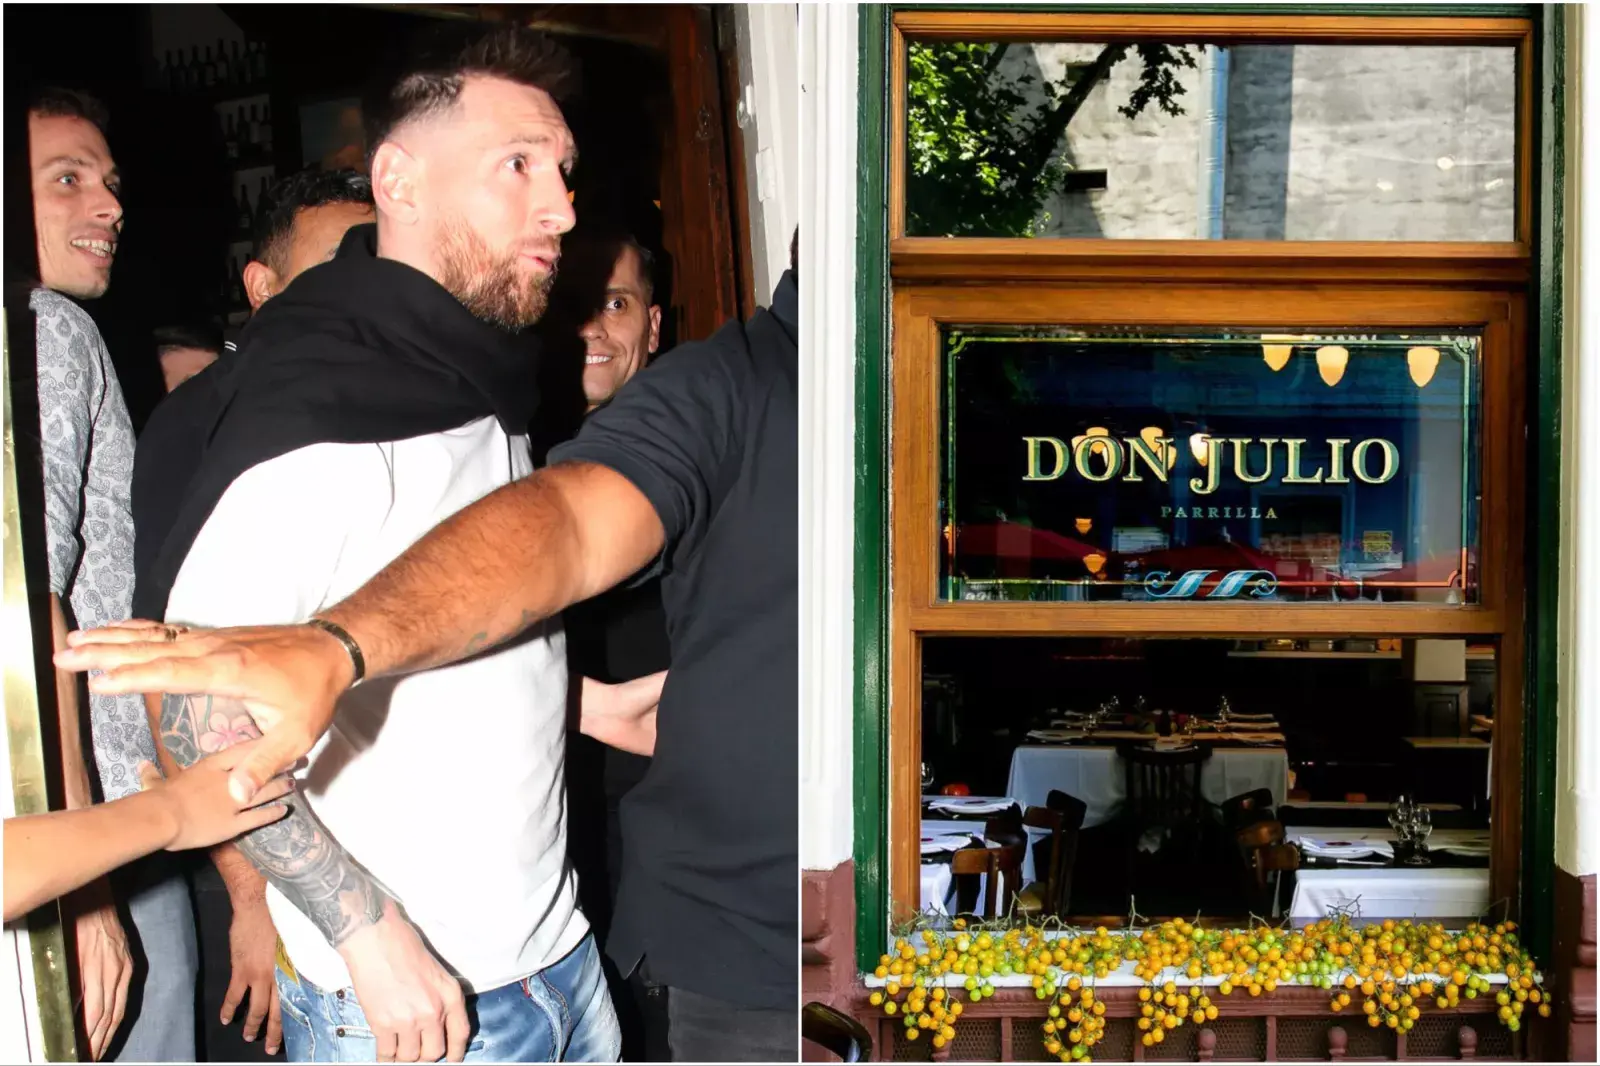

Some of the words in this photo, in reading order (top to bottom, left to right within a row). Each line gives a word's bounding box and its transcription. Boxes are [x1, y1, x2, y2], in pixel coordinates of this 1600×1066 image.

[1022, 435, 1174, 482] DON
[1189, 437, 1400, 494] JULIO
[1160, 506, 1278, 519] PARRILLA
